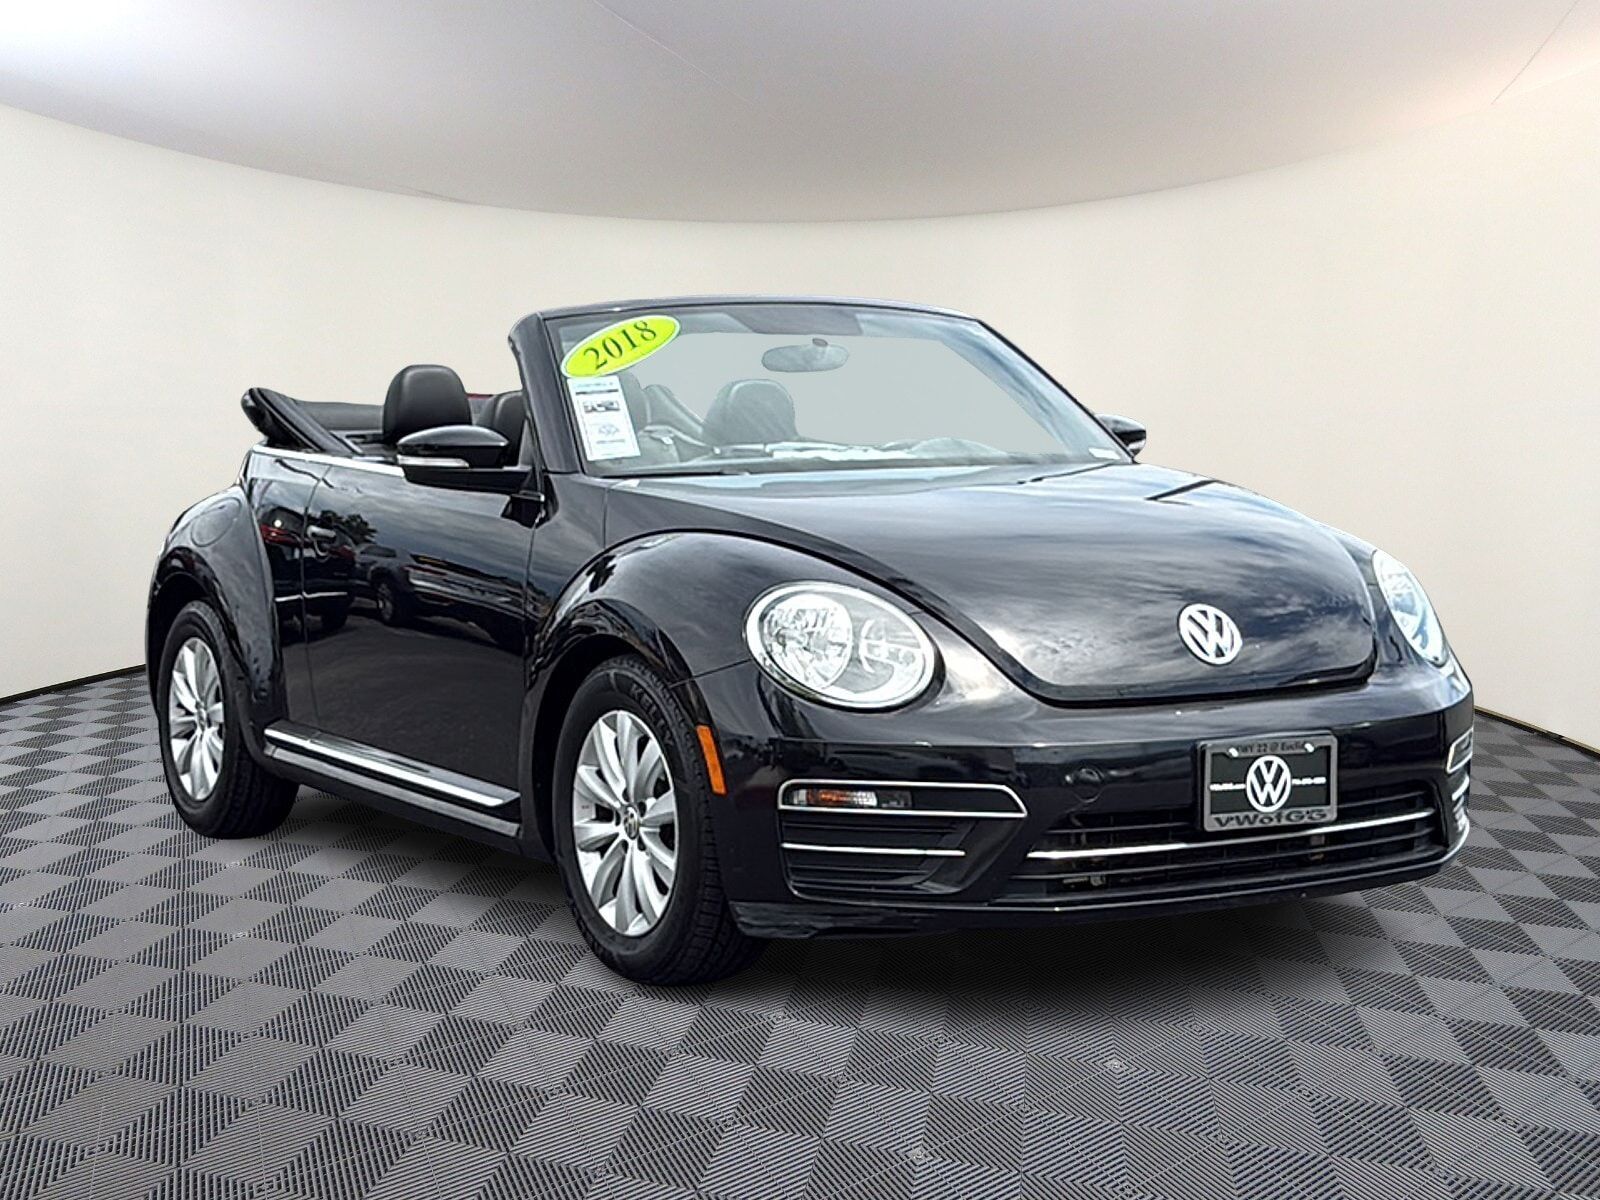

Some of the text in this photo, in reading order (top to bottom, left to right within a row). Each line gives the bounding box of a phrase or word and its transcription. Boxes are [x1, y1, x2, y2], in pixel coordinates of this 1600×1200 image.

[583, 320, 657, 370] 2018
[1179, 603, 1243, 664] VW
[630, 682, 674, 745] KELLY
[1246, 755, 1291, 812] VW
